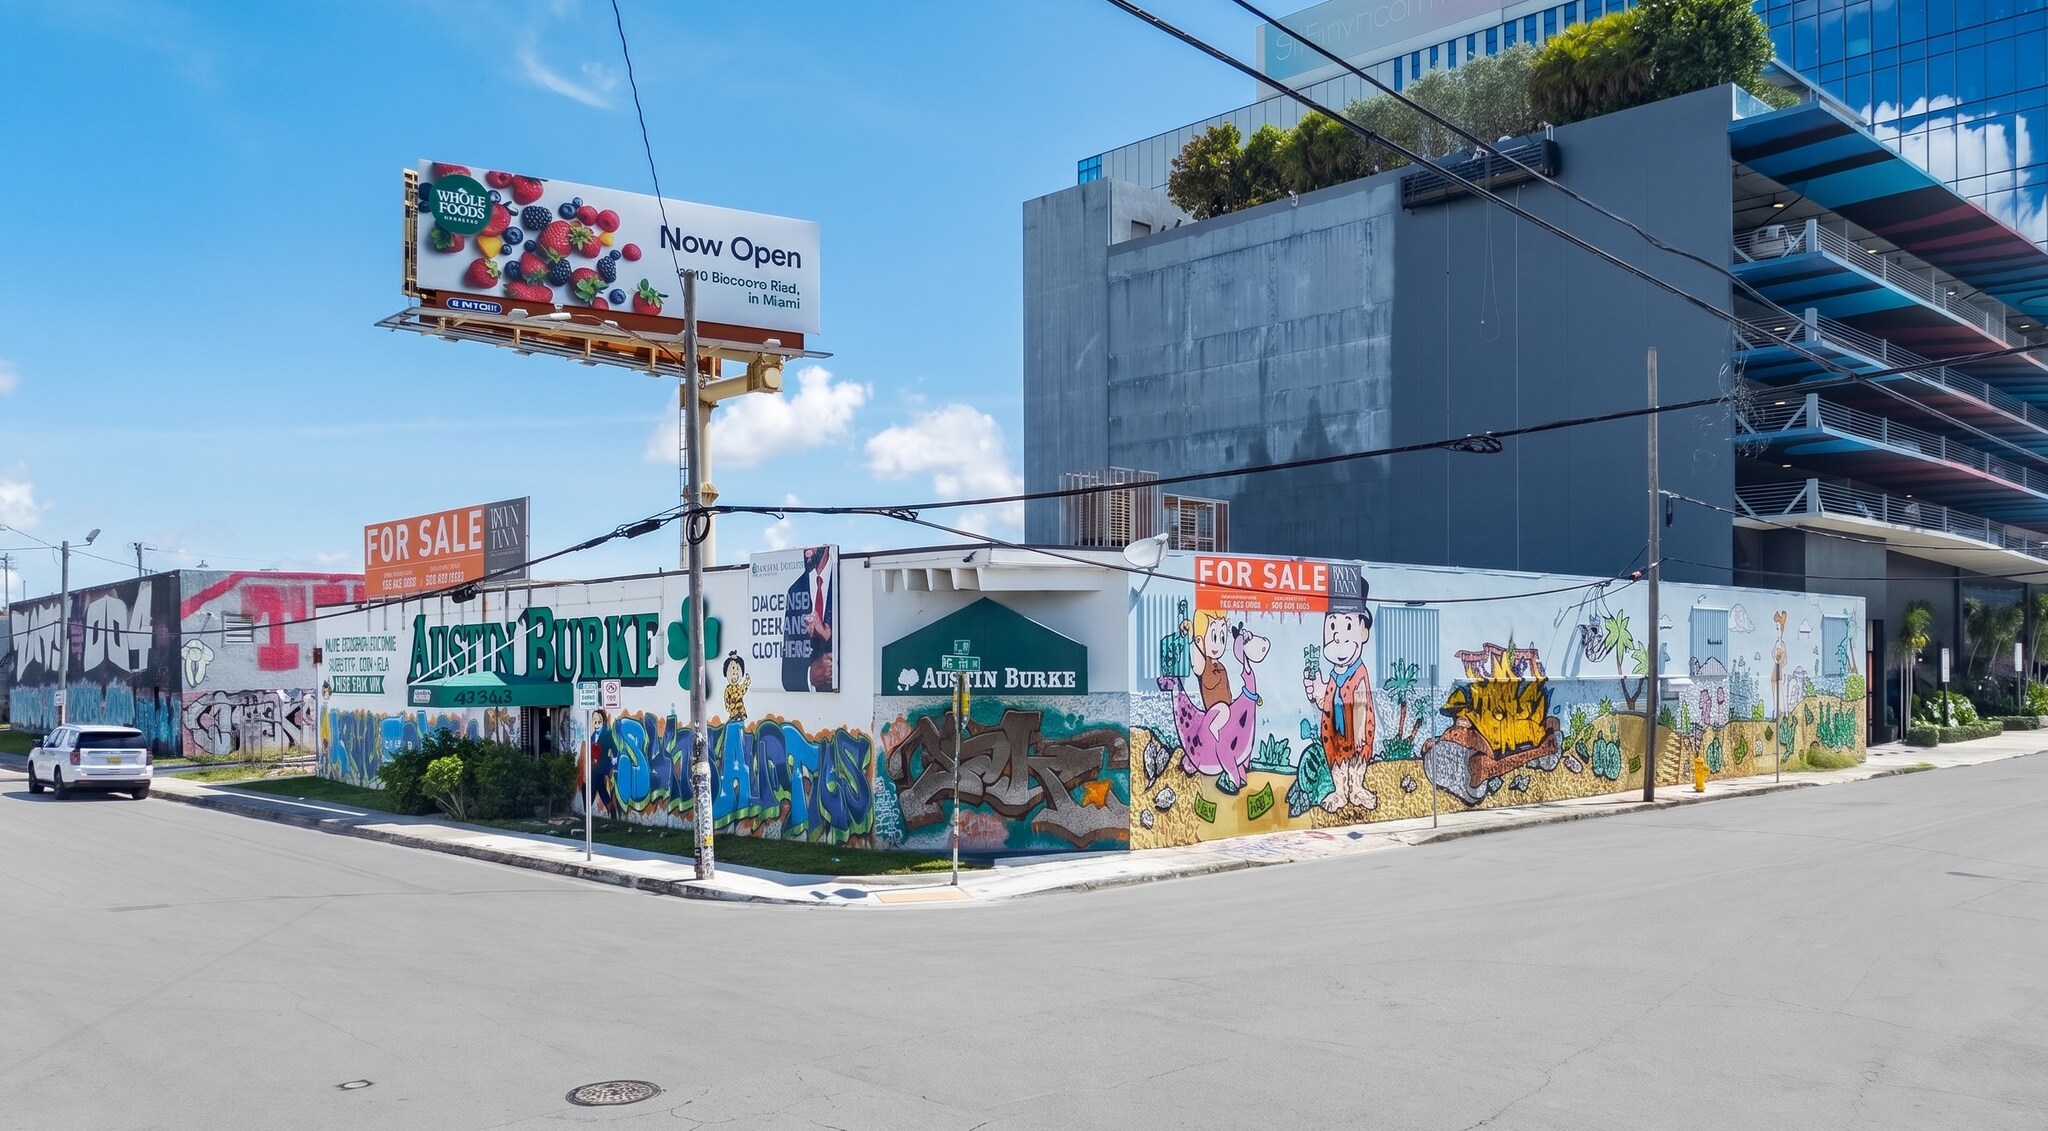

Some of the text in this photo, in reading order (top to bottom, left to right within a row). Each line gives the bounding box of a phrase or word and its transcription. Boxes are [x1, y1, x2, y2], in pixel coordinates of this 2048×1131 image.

[436, 189, 486, 208] WHOLE
[438, 201, 485, 219] FOODS
[660, 225, 802, 269] Now Open
[748, 292, 800, 309] in Miami
[367, 509, 482, 566] FOR SALE
[1199, 559, 1326, 591] FOR SALE
[407, 606, 659, 687] AUSTIN BURKE
[1004, 667, 1076, 689] BURKE
